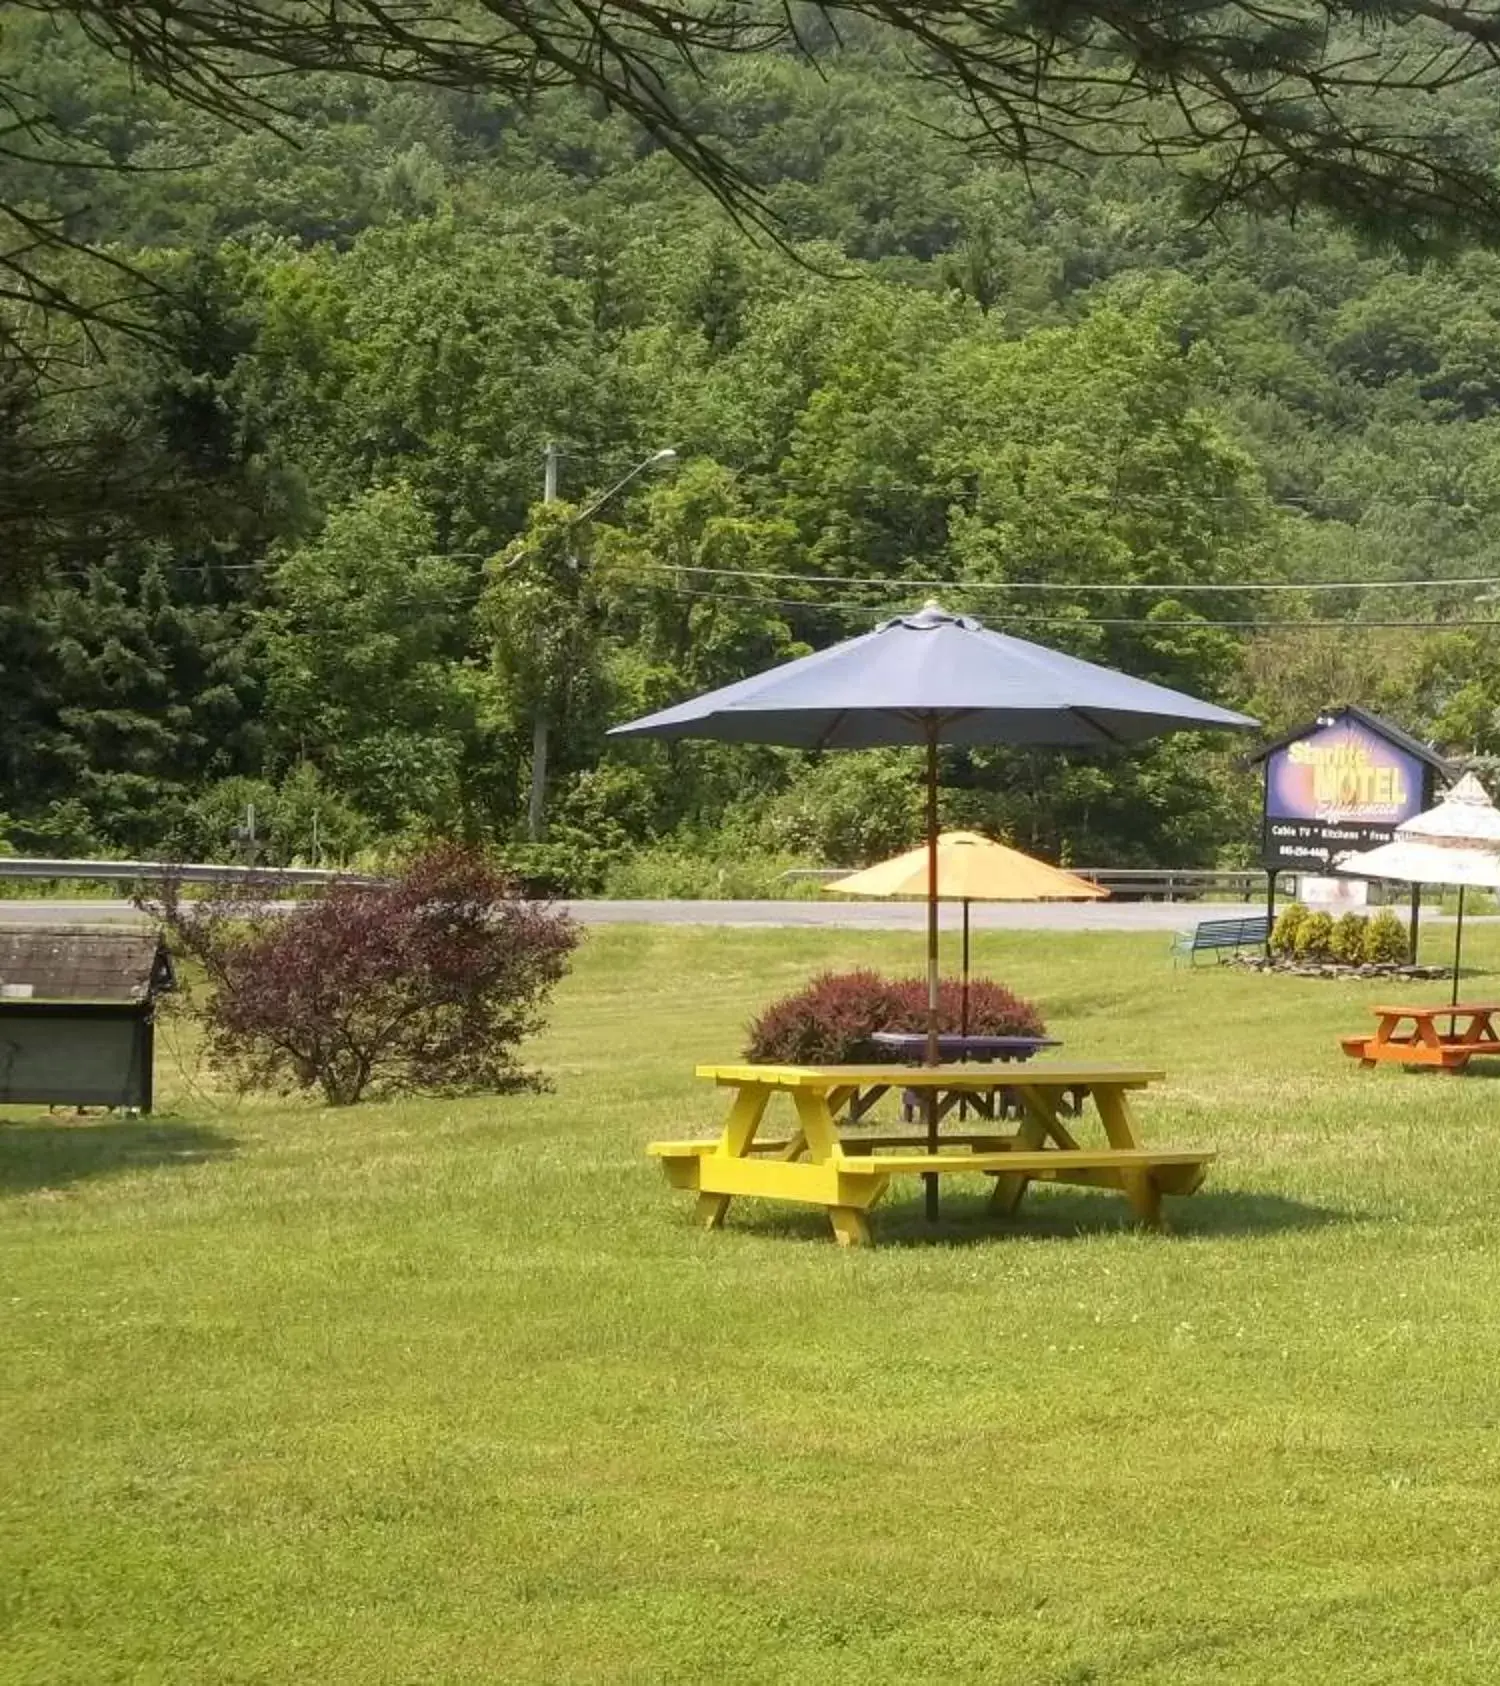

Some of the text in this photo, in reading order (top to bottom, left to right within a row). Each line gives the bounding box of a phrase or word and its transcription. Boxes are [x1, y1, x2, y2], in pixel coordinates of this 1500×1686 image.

[1288, 741, 1367, 767] Starlite
[1313, 767, 1407, 804] MOTEL
[1271, 825, 1297, 837] Cable
[1299, 827, 1312, 838] TV
[1321, 828, 1359, 840] Kitchens
